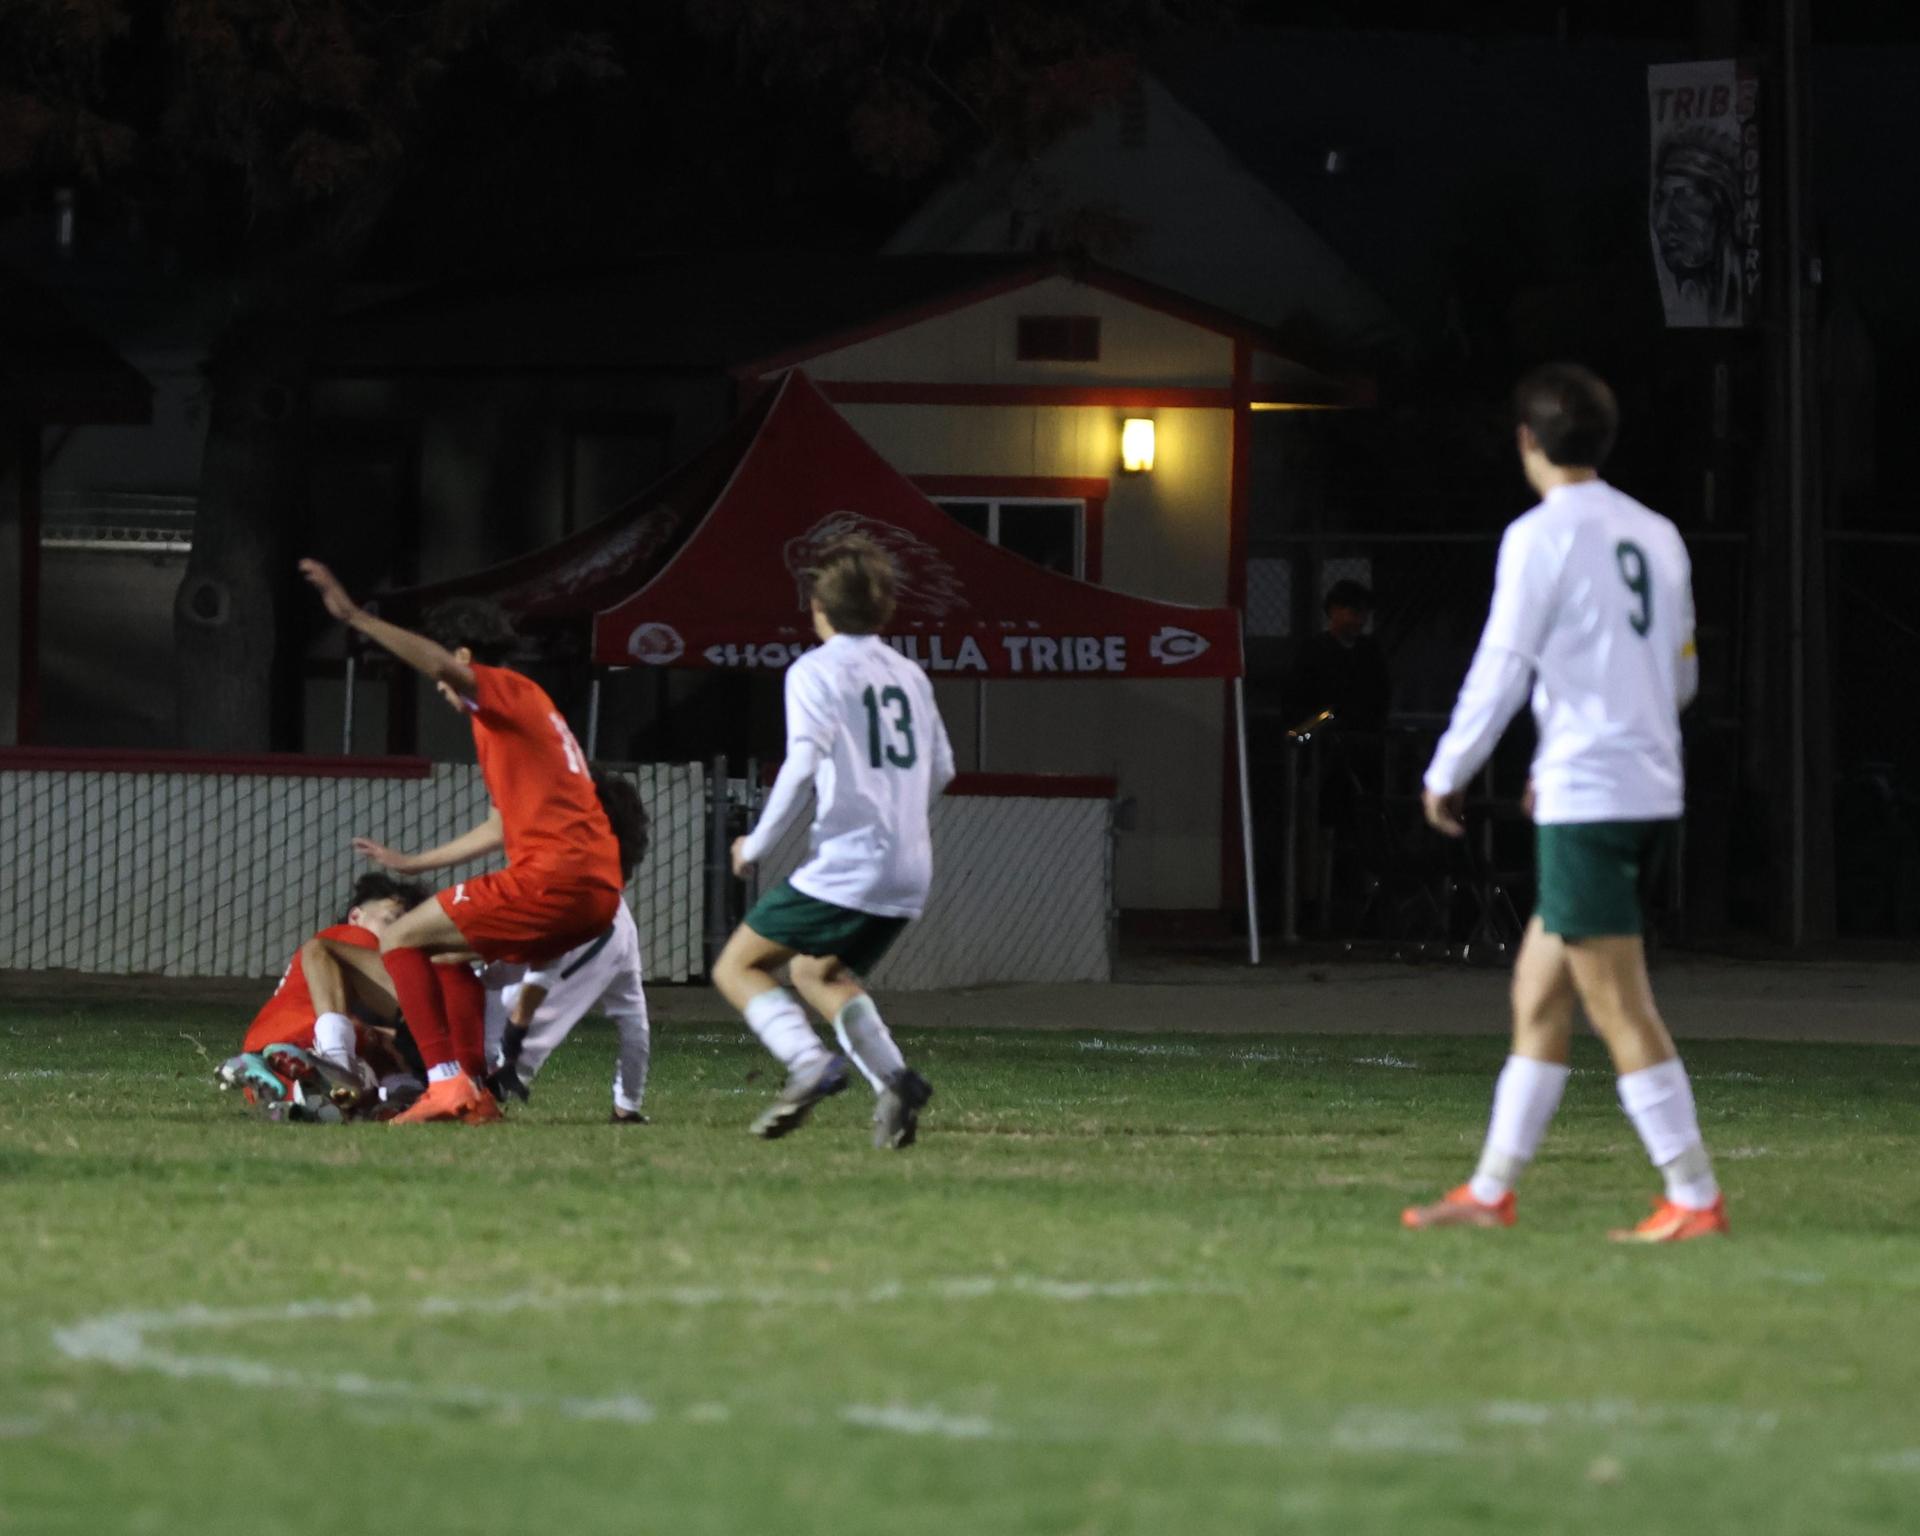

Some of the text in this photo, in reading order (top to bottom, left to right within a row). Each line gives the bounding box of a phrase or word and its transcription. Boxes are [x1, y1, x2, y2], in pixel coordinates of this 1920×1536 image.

[1744, 123, 1760, 296] COUNTRY
[1615, 540, 1652, 636] 9
[1002, 635, 1126, 672] TRIBE
[863, 684, 917, 769] 13
